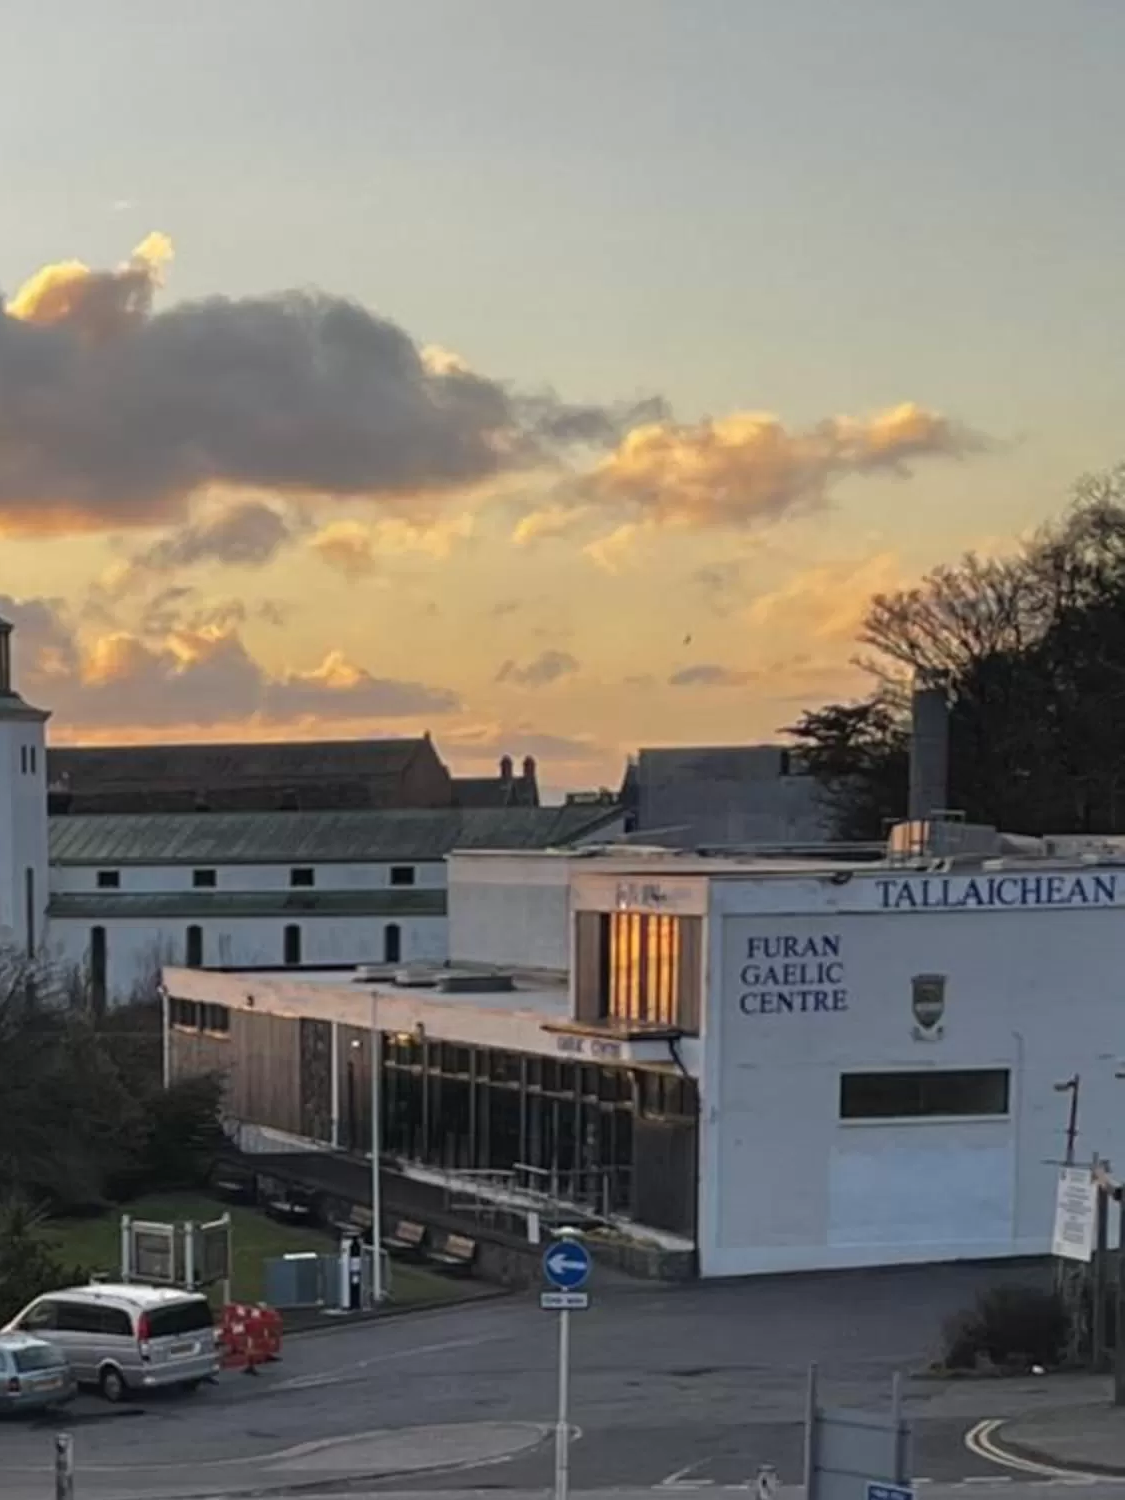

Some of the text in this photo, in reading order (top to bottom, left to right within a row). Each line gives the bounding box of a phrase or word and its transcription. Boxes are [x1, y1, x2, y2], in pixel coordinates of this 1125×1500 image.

[876, 876, 1117, 908] TALLAICHEAN
[747, 935, 841, 958] FURAN
[740, 962, 844, 985] GAELIC
[739, 988, 850, 1014] CENTRE
